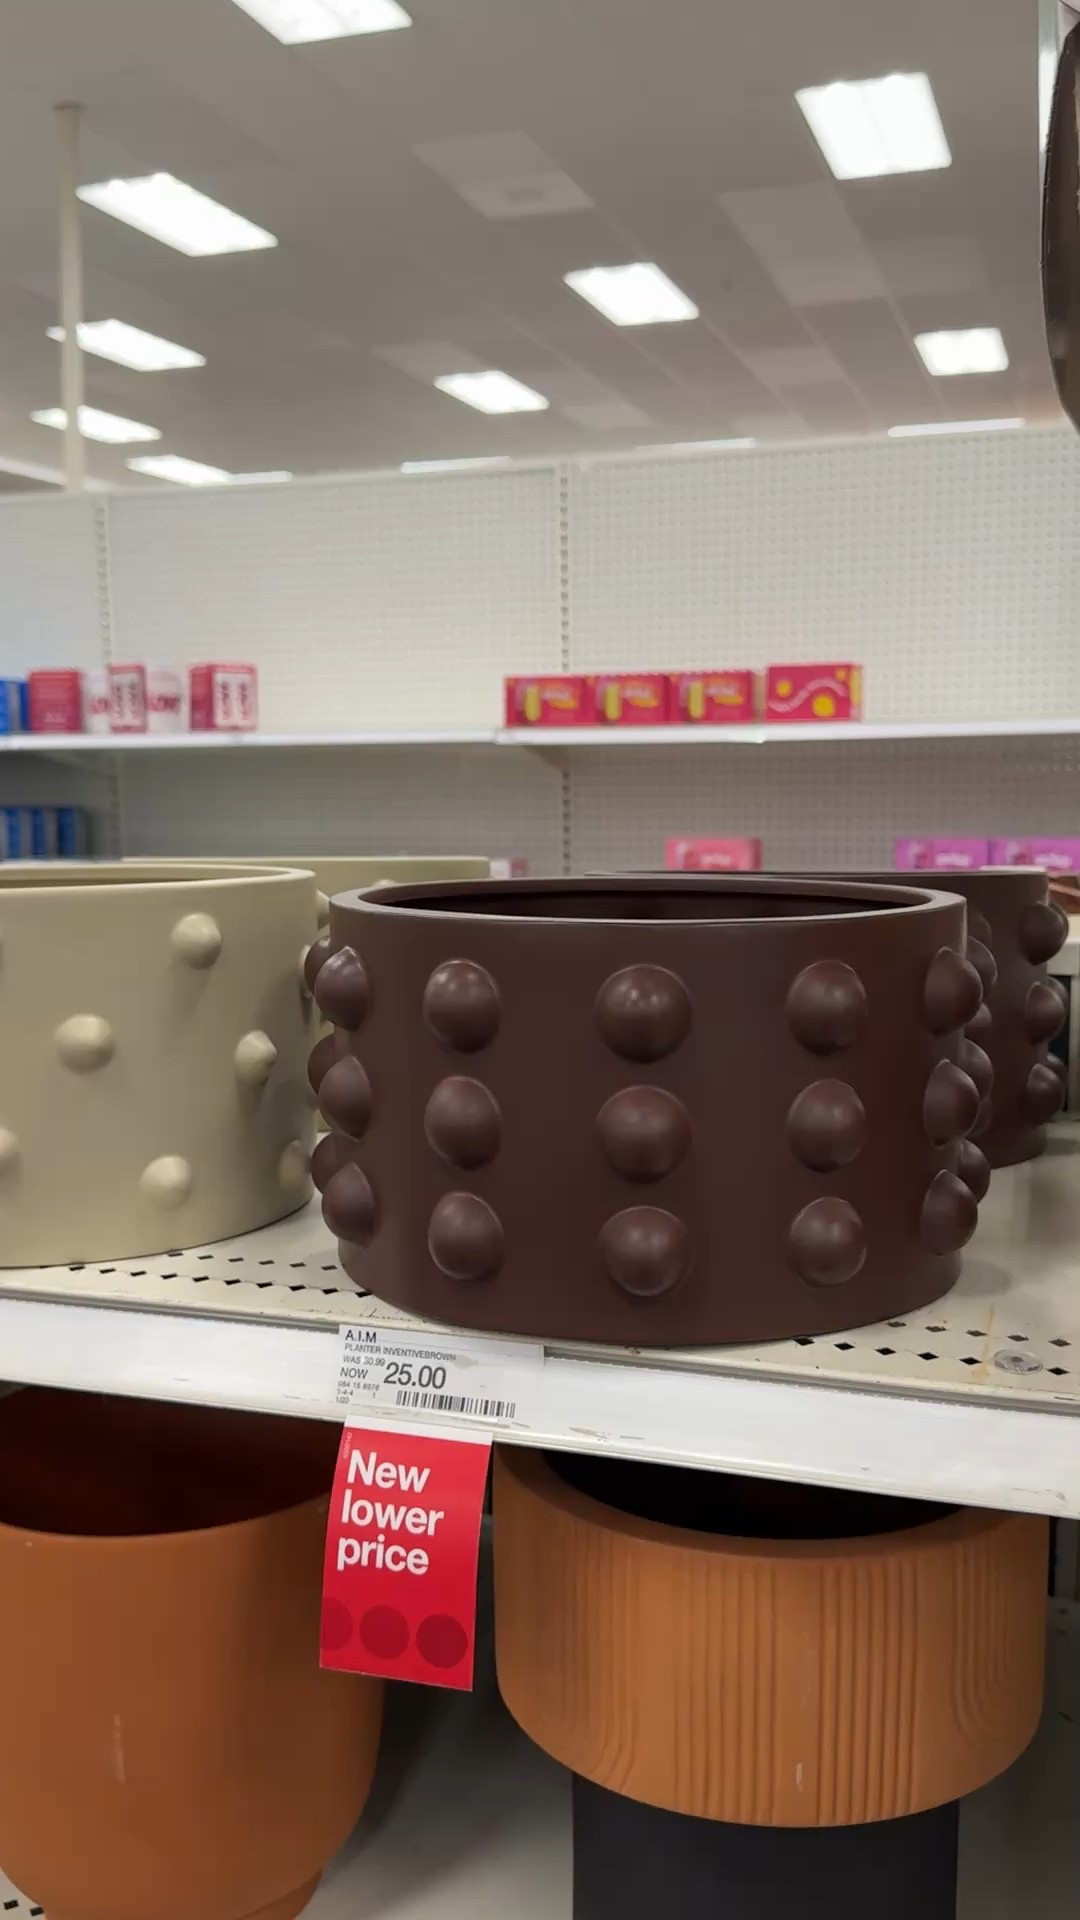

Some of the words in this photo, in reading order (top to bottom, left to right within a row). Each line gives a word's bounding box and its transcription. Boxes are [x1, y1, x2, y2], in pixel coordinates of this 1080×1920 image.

[345, 1330, 377, 1343] A.I.M
[343, 1356, 361, 1364] WAS
[363, 1356, 385, 1367] 30.99
[344, 1343, 381, 1354] PLANTER
[383, 1346, 457, 1361] INVENTIVEBROWN
[340, 1367, 369, 1379] NOW
[383, 1362, 447, 1389] 25.00
[347, 1449, 431, 1493] New
[341, 1489, 445, 1536] lower
[336, 1534, 430, 1575] price
